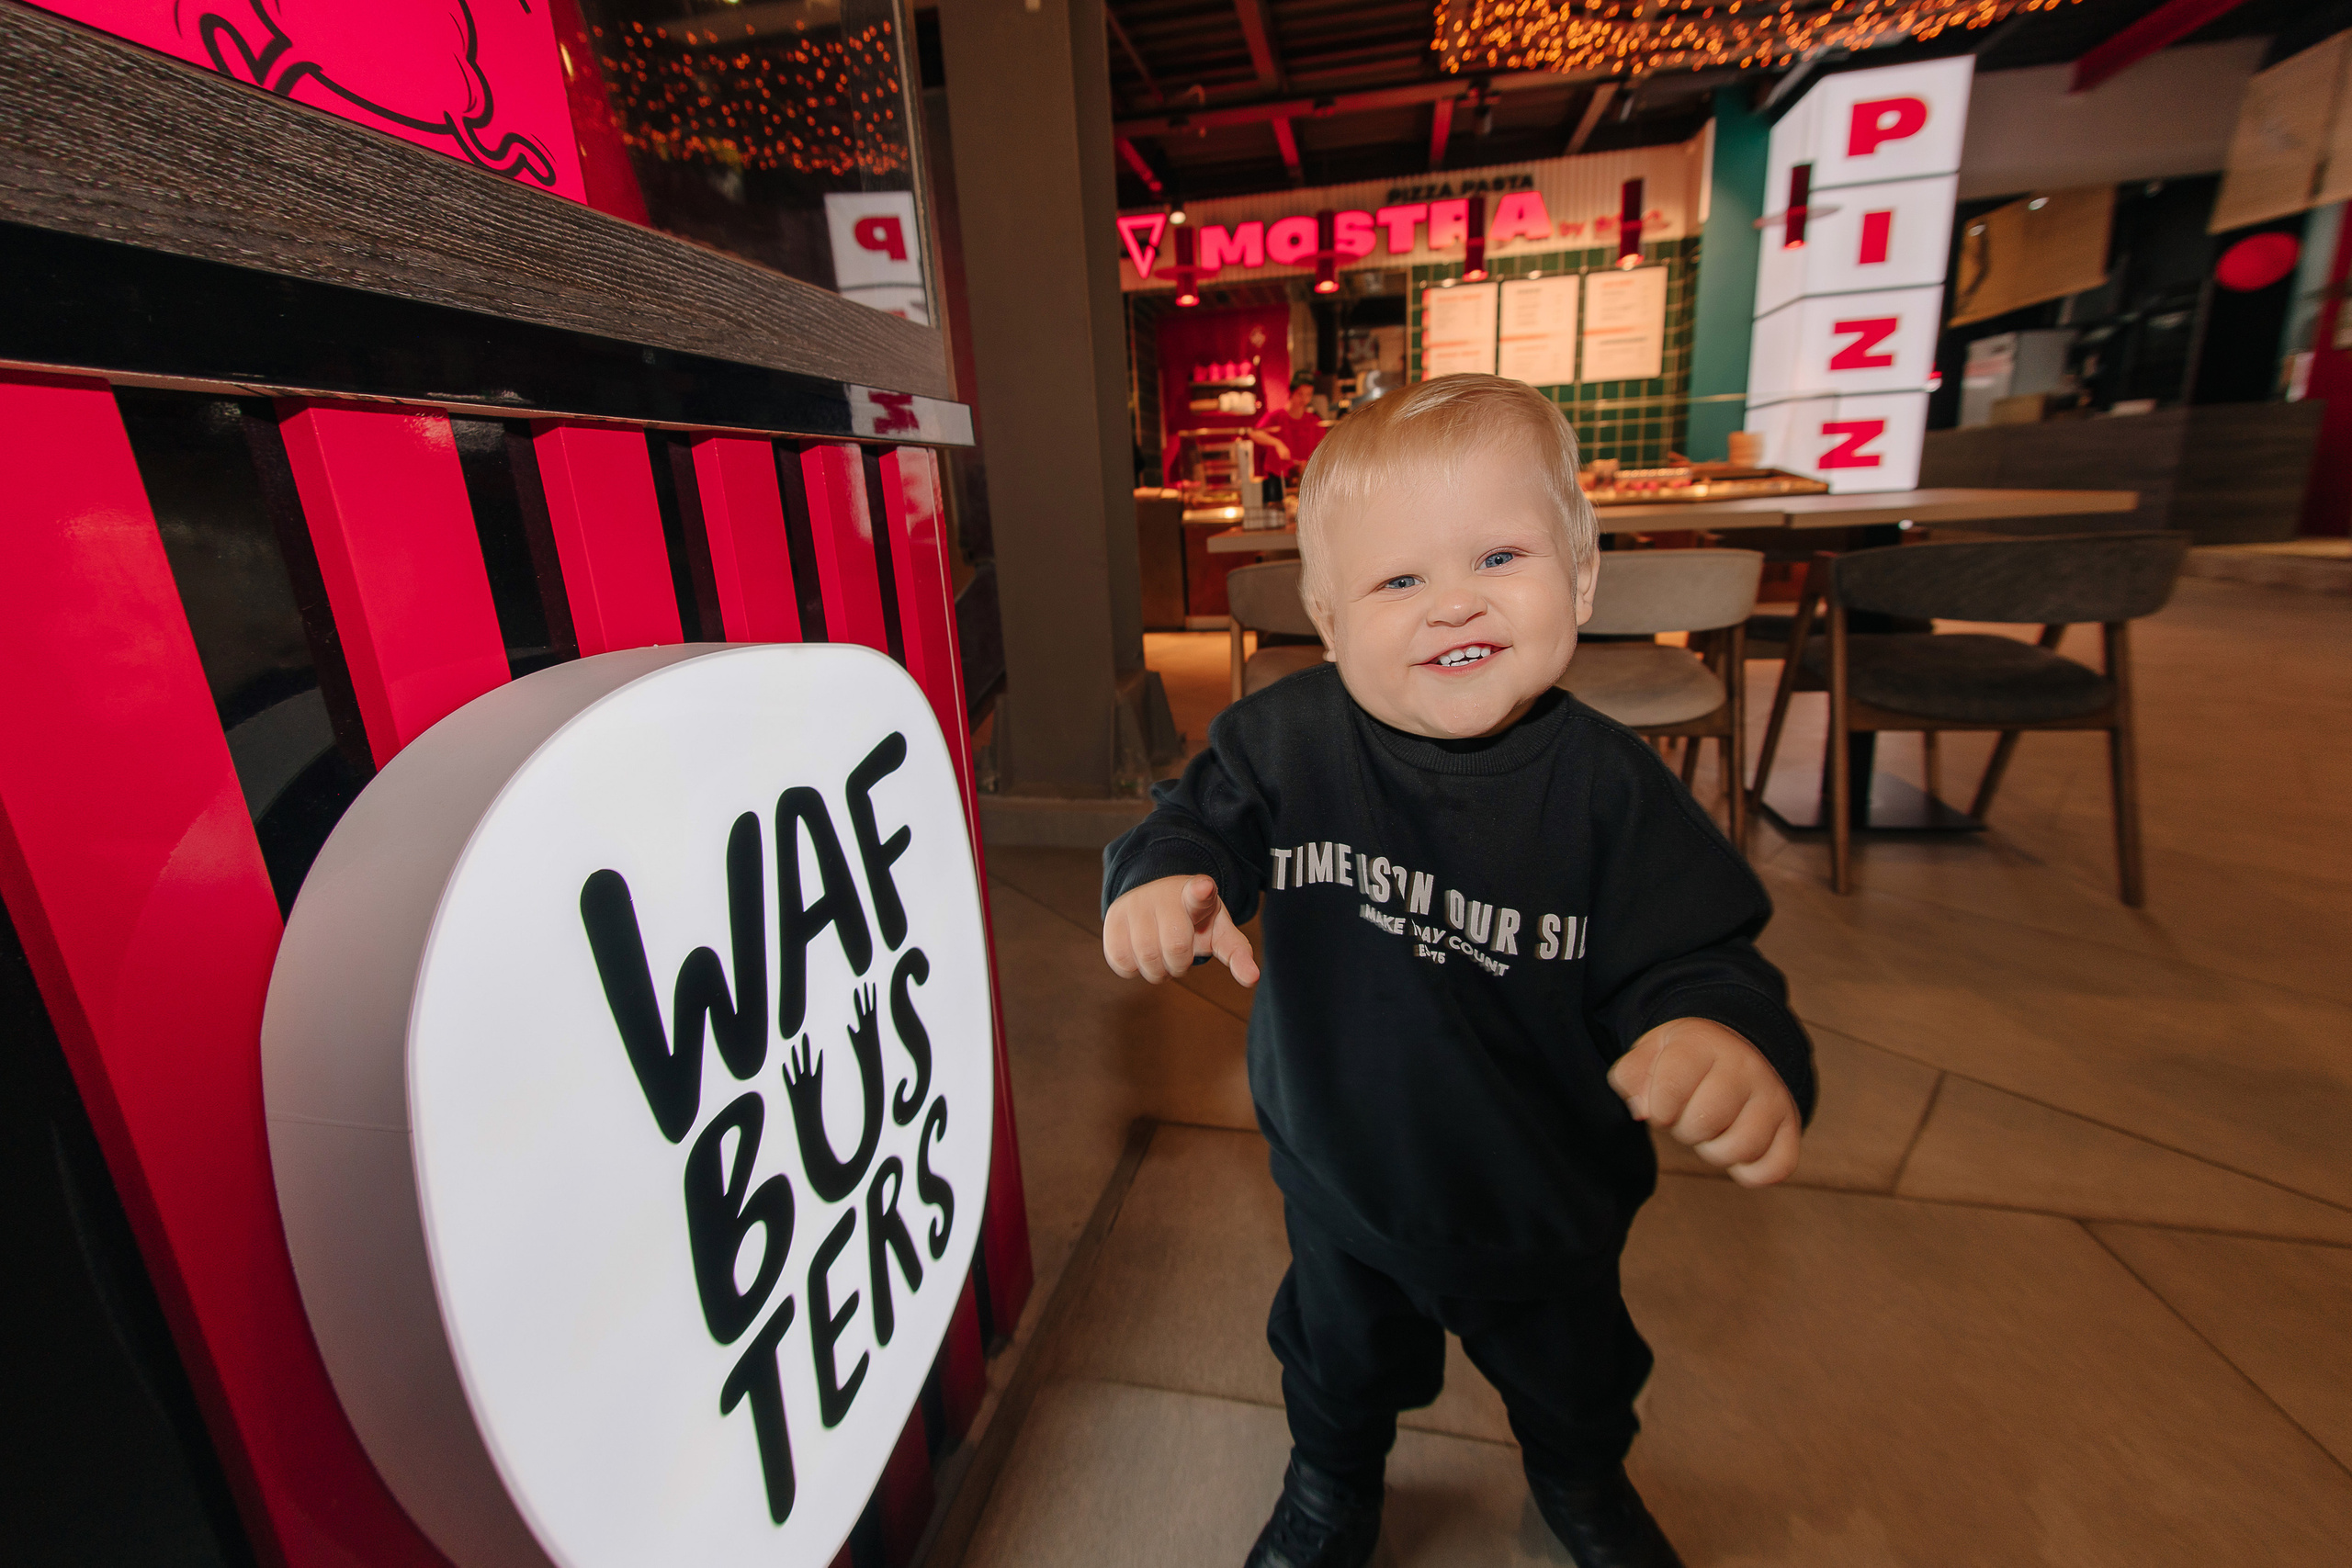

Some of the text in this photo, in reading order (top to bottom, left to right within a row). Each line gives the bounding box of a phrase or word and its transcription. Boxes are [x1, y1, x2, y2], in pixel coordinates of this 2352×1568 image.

[1386, 174, 1534, 205] PIZZA PASTA
[579, 731, 912, 1145] WAF
[1272, 840, 1353, 890] TIME
[1356, 852, 1391, 904] IS
[1445, 888, 1521, 955] OUR
[1361, 903, 1407, 935] MAKE
[1448, 935, 1510, 976] COUNT
[684, 946, 933, 1347] BUS
[719, 1095, 956, 1526] TERS
